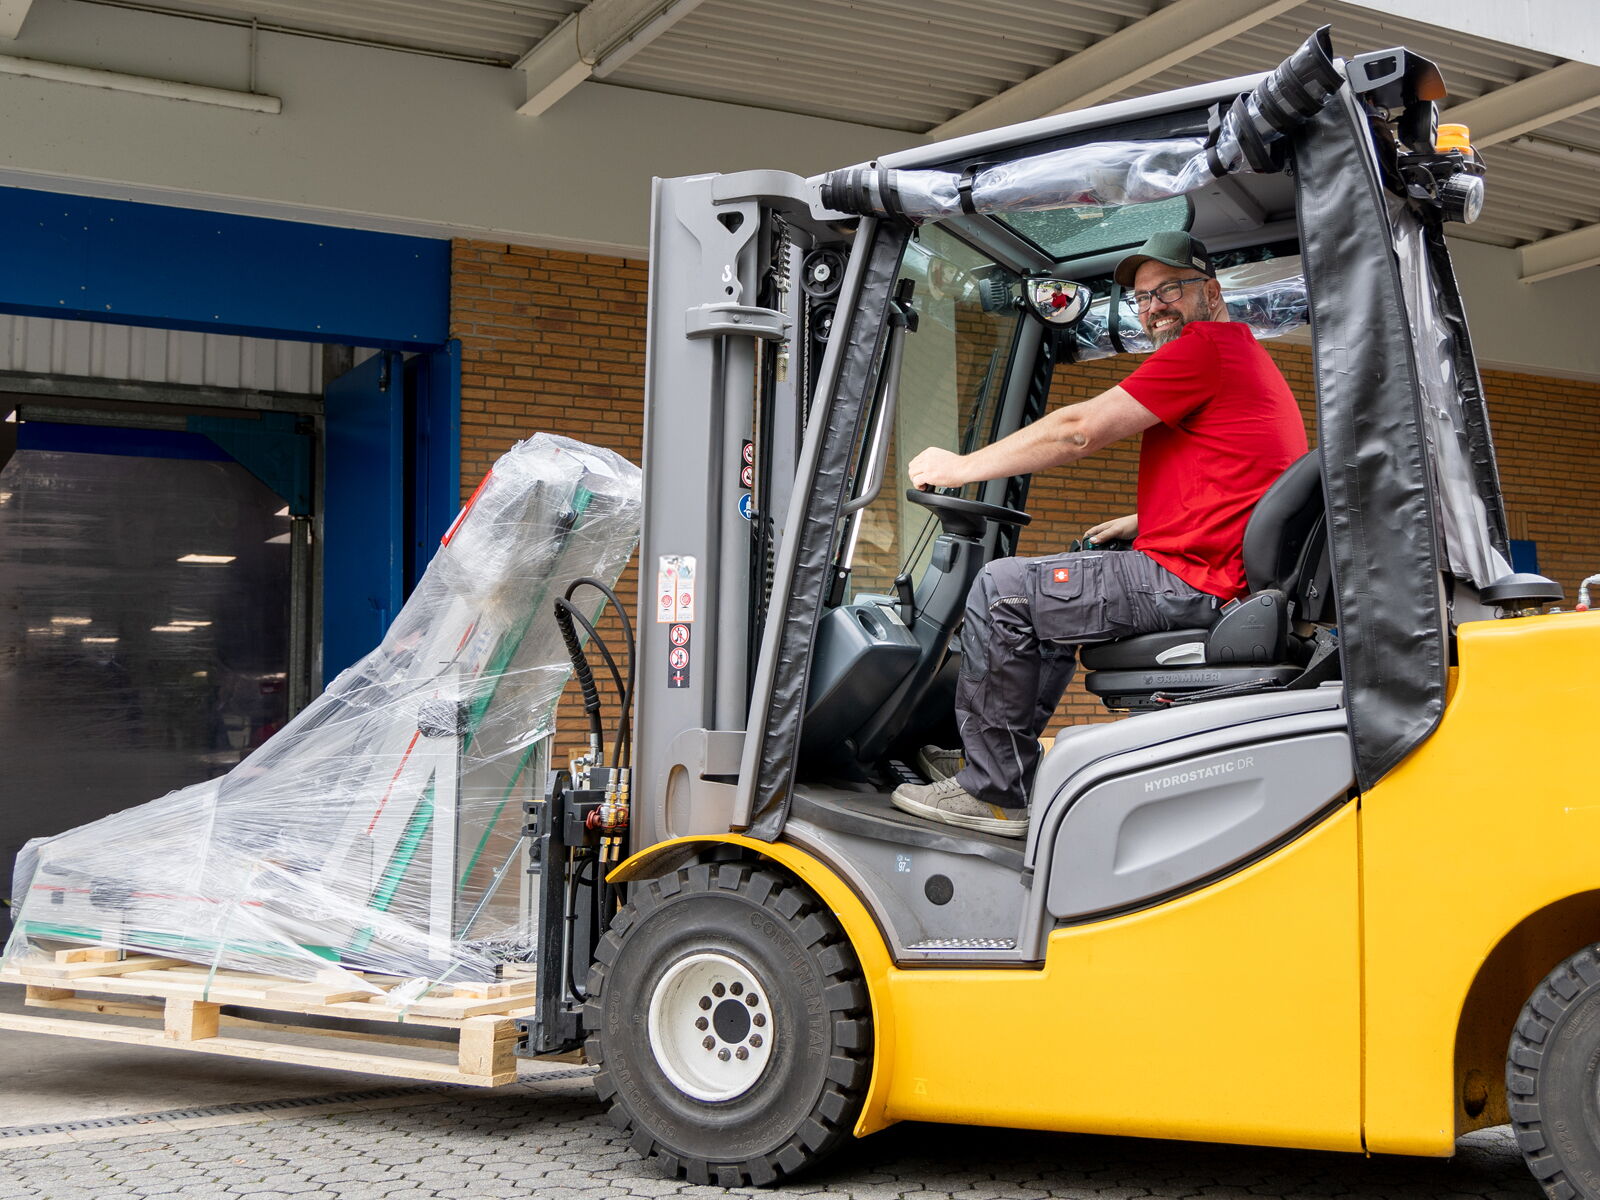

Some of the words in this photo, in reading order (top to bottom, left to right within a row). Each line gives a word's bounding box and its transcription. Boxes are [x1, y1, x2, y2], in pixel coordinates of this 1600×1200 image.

[1156, 672, 1221, 684] GRAMMER
[1144, 762, 1235, 792] HYDROSTATIC
[1237, 756, 1255, 769] DR
[750, 911, 825, 1060] CONTINENTAL
